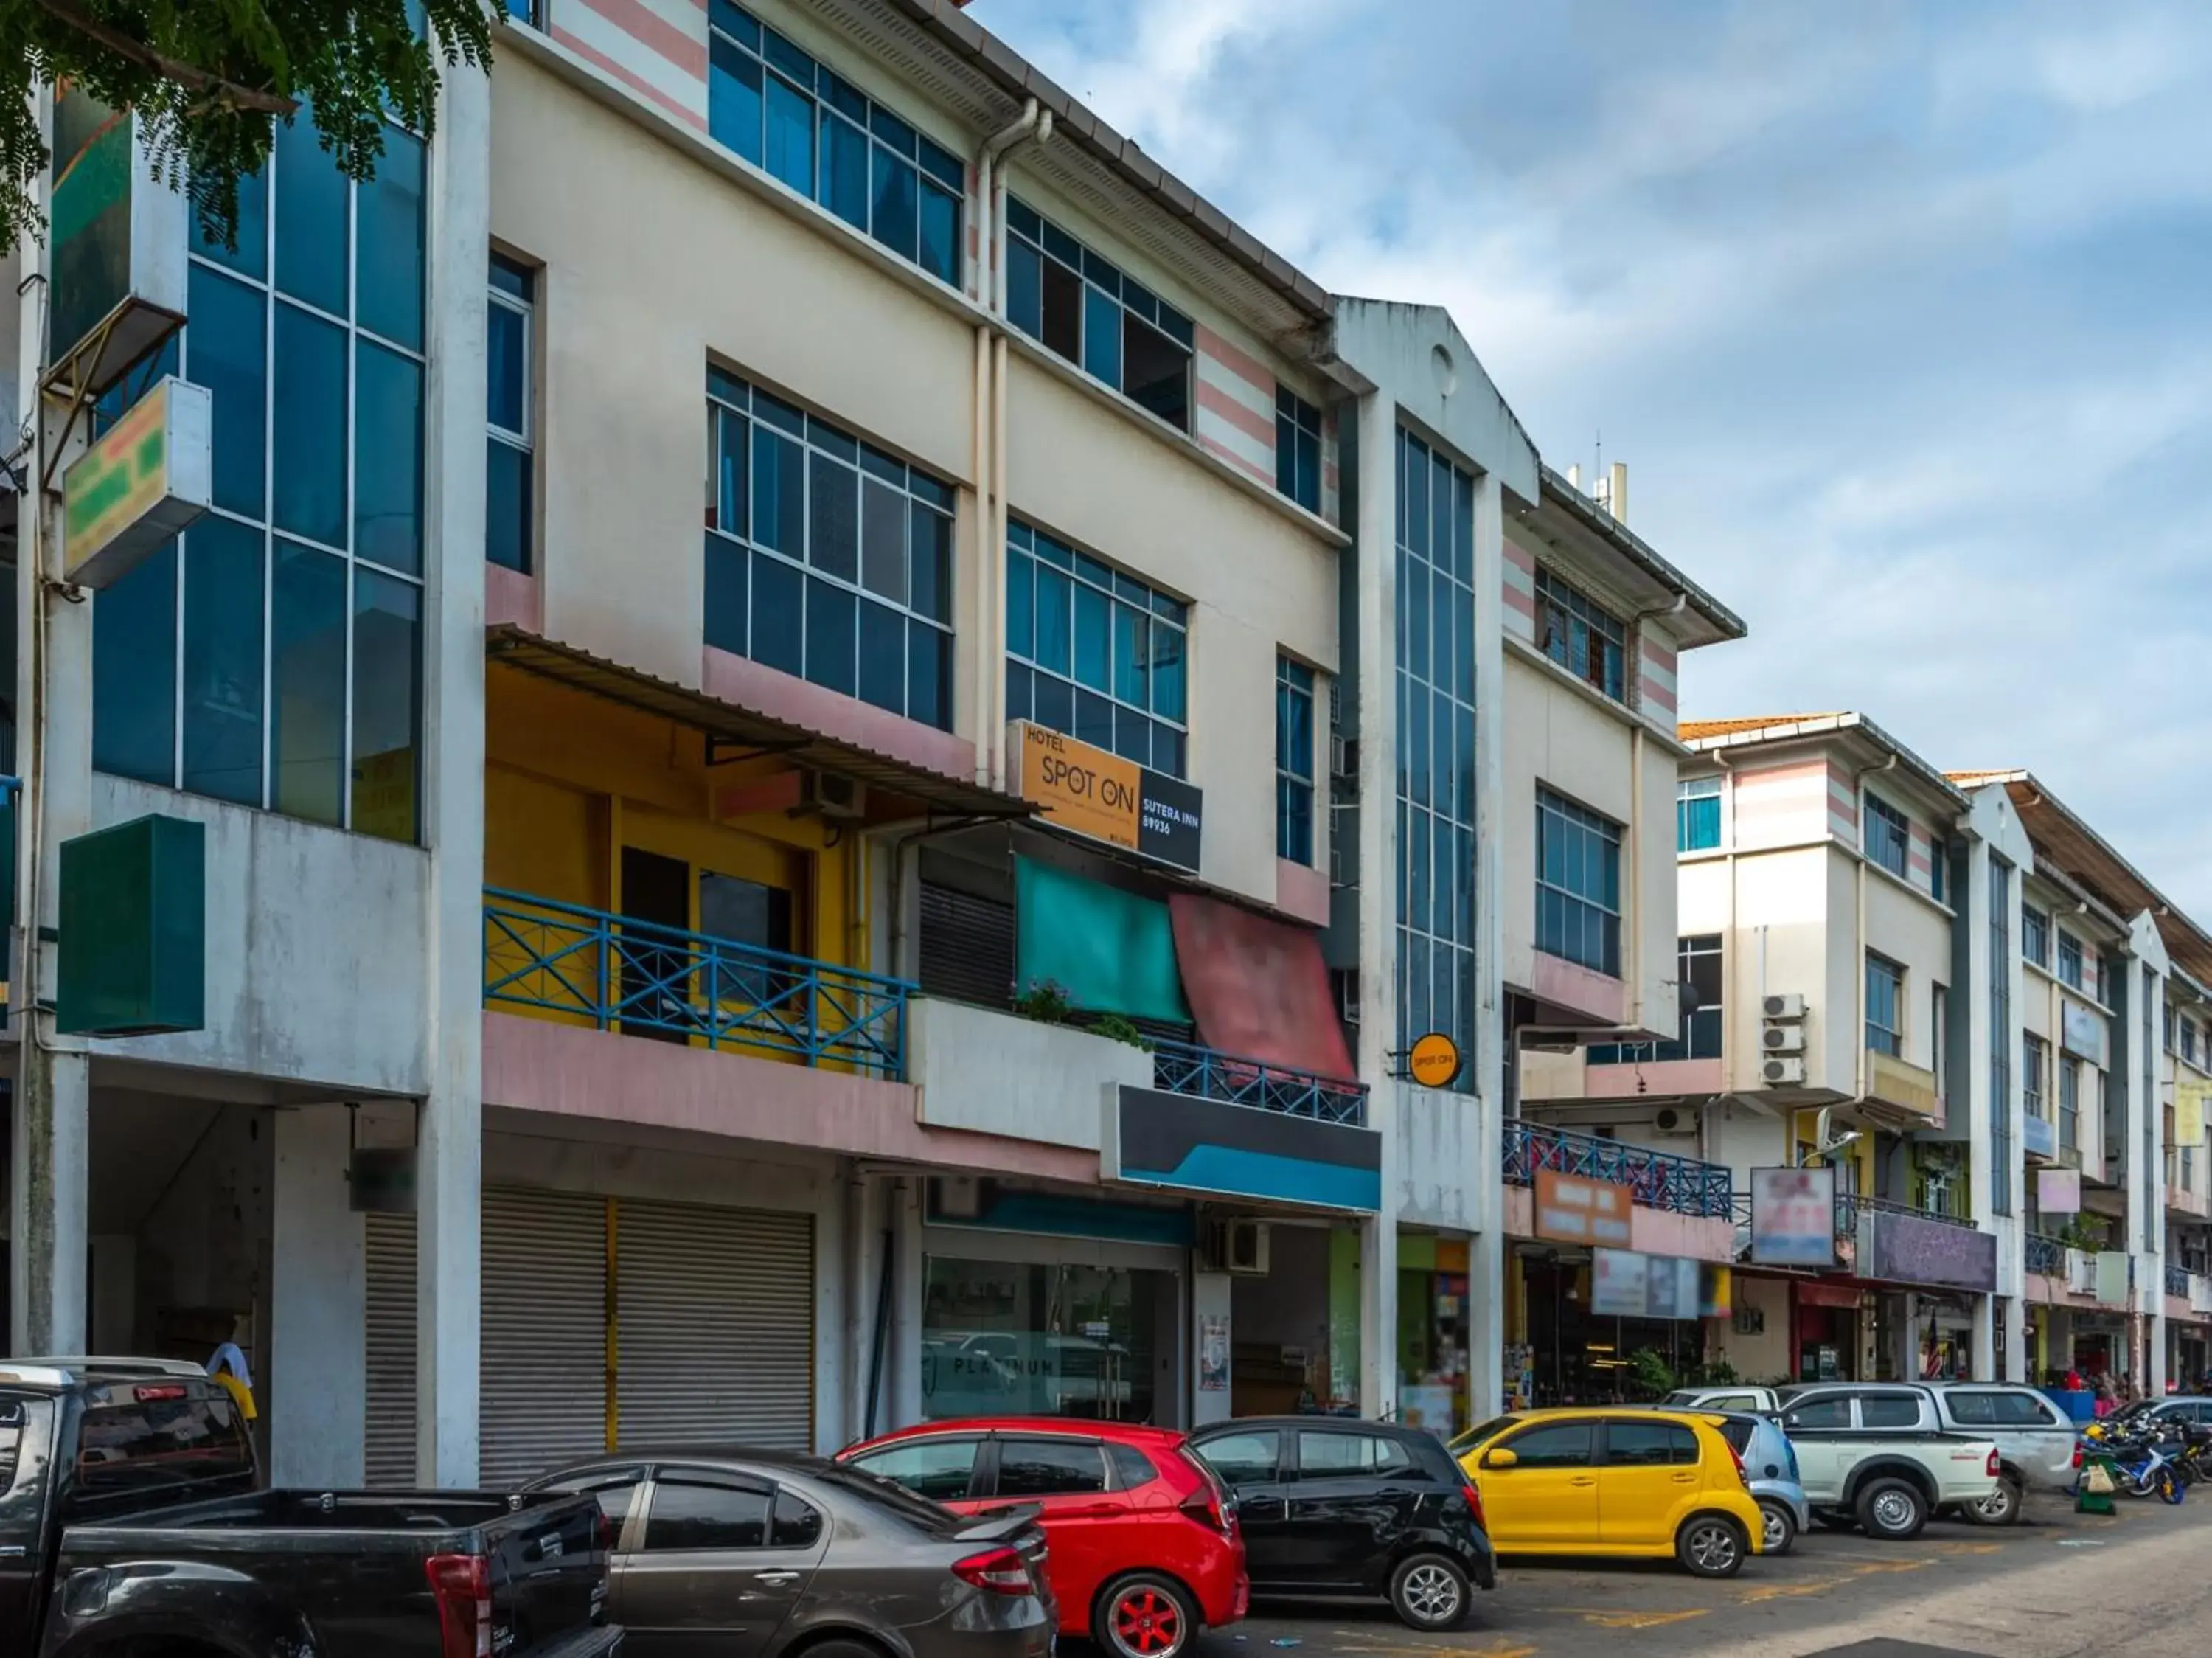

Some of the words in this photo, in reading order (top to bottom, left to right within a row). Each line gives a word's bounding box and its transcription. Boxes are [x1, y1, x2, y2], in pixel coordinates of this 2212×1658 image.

[1027, 727, 1065, 753] HOTEL
[1042, 755, 1096, 799] SPOT
[1101, 778, 1133, 814] ON
[1144, 798, 1180, 822] SUTERA
[1182, 811, 1199, 828] INN
